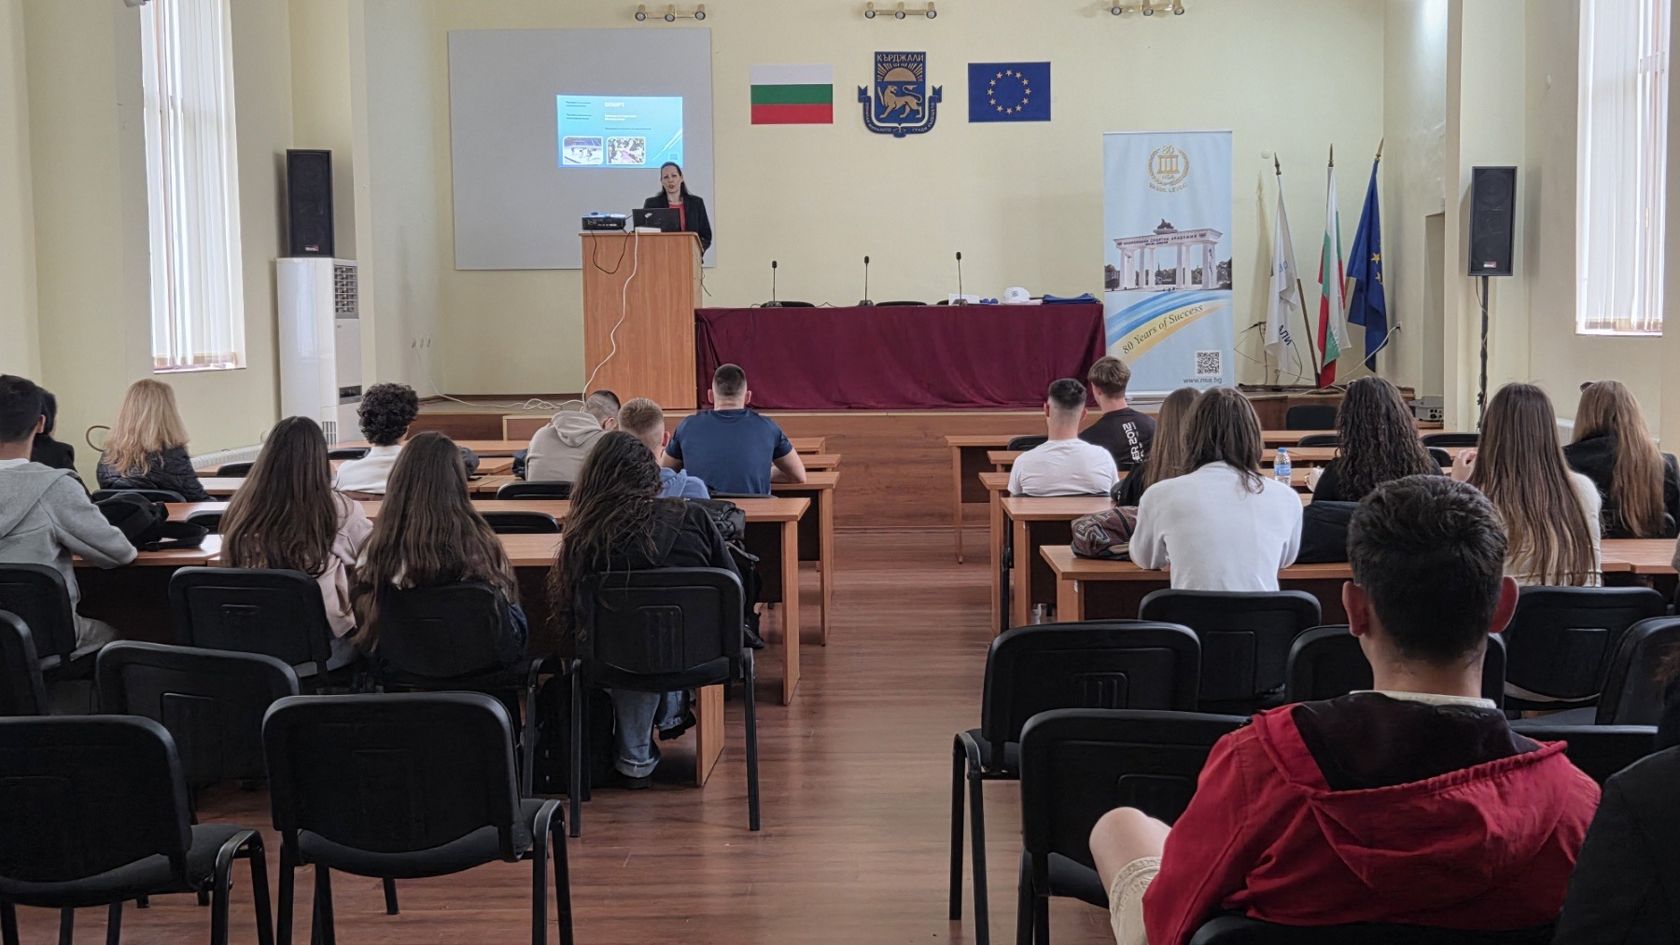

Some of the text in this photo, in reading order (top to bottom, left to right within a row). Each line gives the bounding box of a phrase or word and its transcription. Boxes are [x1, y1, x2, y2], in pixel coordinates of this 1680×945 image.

[876, 54, 924, 63] КЪРДЖАЛИ
[1122, 305, 1204, 354] 80 Years of Success
